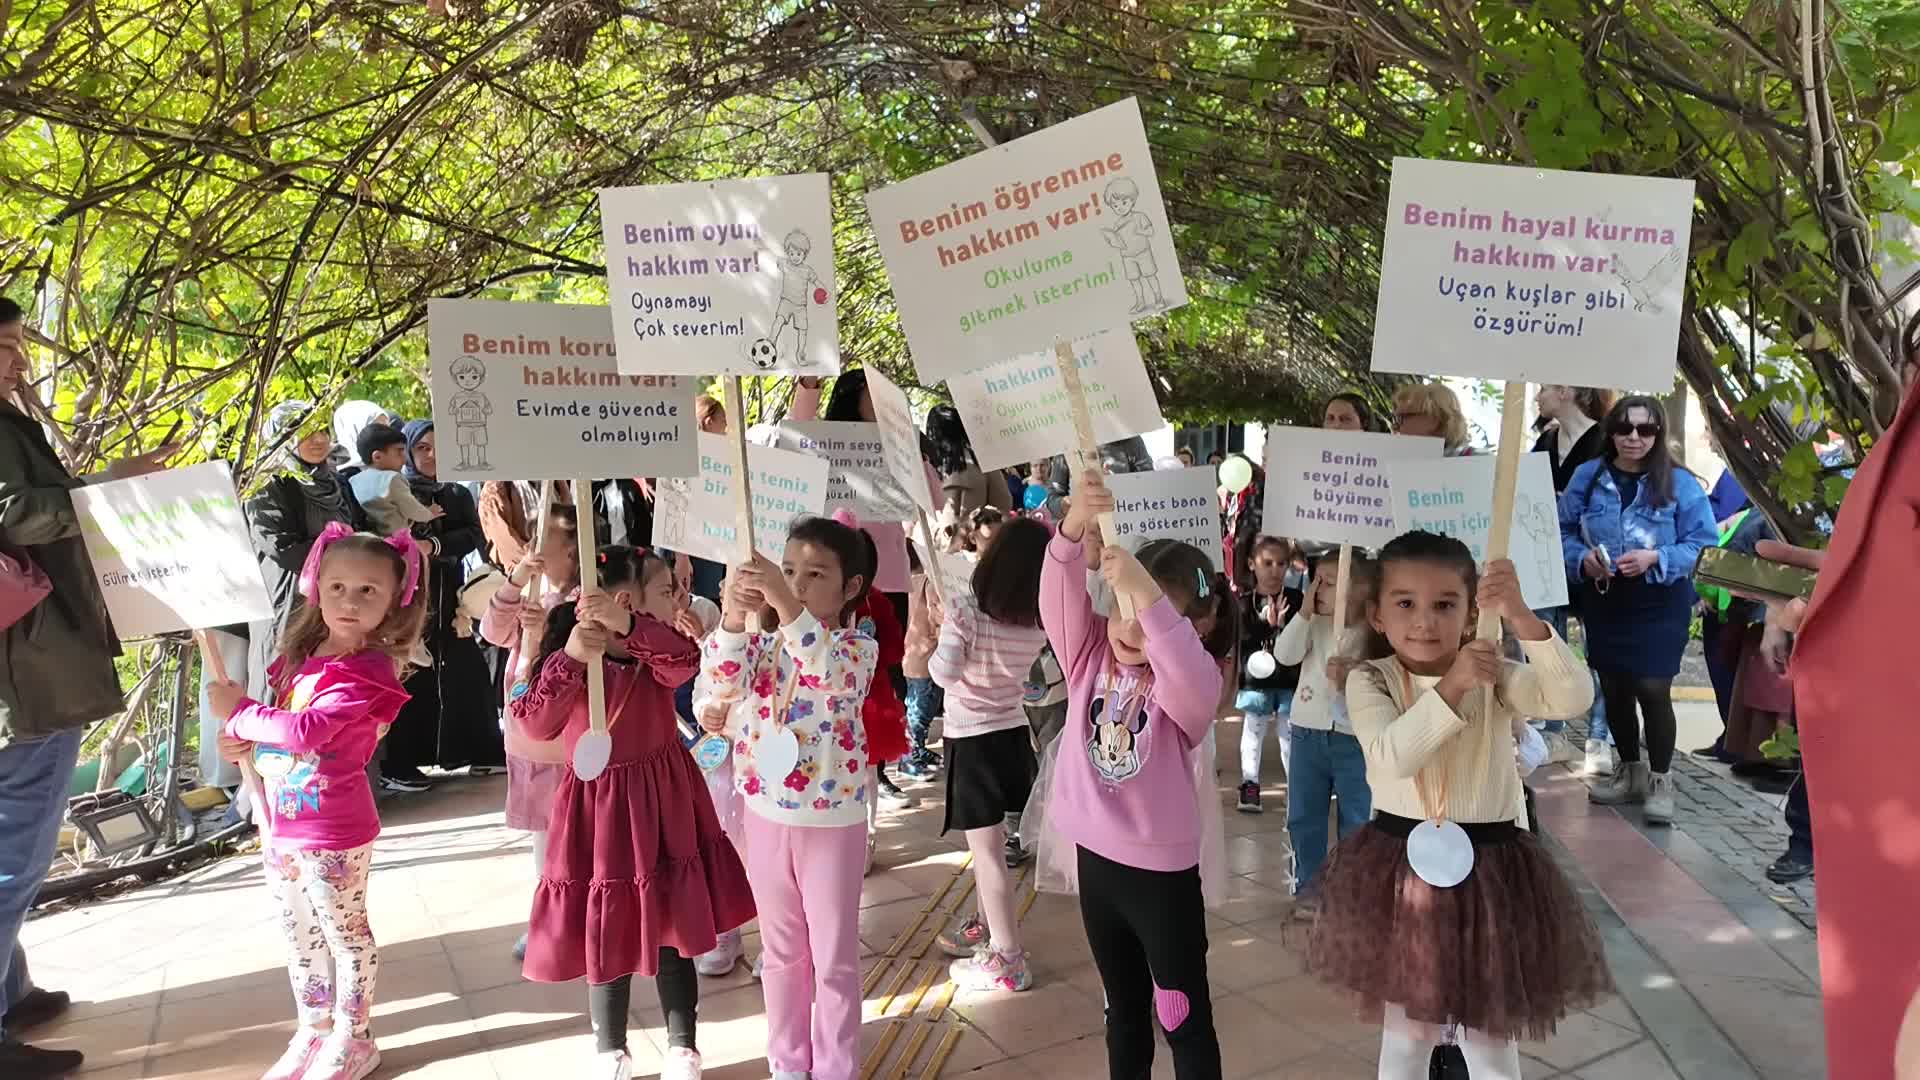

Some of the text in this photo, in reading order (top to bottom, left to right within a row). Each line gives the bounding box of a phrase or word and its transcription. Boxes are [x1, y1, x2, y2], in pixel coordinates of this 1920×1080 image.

[900, 152, 1124, 244] Benim öğrenme
[624, 221, 695, 244] Benim
[937, 192, 1102, 268] hakkım var!
[1404, 203, 1675, 246] Benim hayal kurma
[627, 251, 760, 277] hakkım var!
[1453, 240, 1618, 274] hakkım var!
[983, 248, 1073, 289] Okuluma
[631, 292, 712, 314] Oynamayı
[960, 262, 1118, 333] gitmek isterim!
[1438, 276, 1626, 311] Uçan kuşlar gibi
[633, 317, 744, 341] Çok severim!
[1474, 307, 1584, 337] özgürüm!
[462, 333, 617, 357] Benim koru
[523, 366, 621, 387] hakkım
[984, 367, 1055, 394] hakkım
[516, 399, 678, 420] Evimde güvende
[581, 425, 679, 446] olmalıyım!
[800, 438, 883, 454] Benim sevg
[856, 456, 884, 468] var!
[1321, 450, 1378, 468] Benim
[704, 479, 729, 496] bir
[760, 471, 809, 494] temiz
[1303, 471, 1348, 487] sevgi
[1116, 497, 1208, 513] Herkes bana
[1313, 488, 1384, 508] büyüme
[1408, 487, 1464, 508] Benim
[1139, 515, 1209, 533] göstersin
[1296, 505, 1358, 525] hakkım
